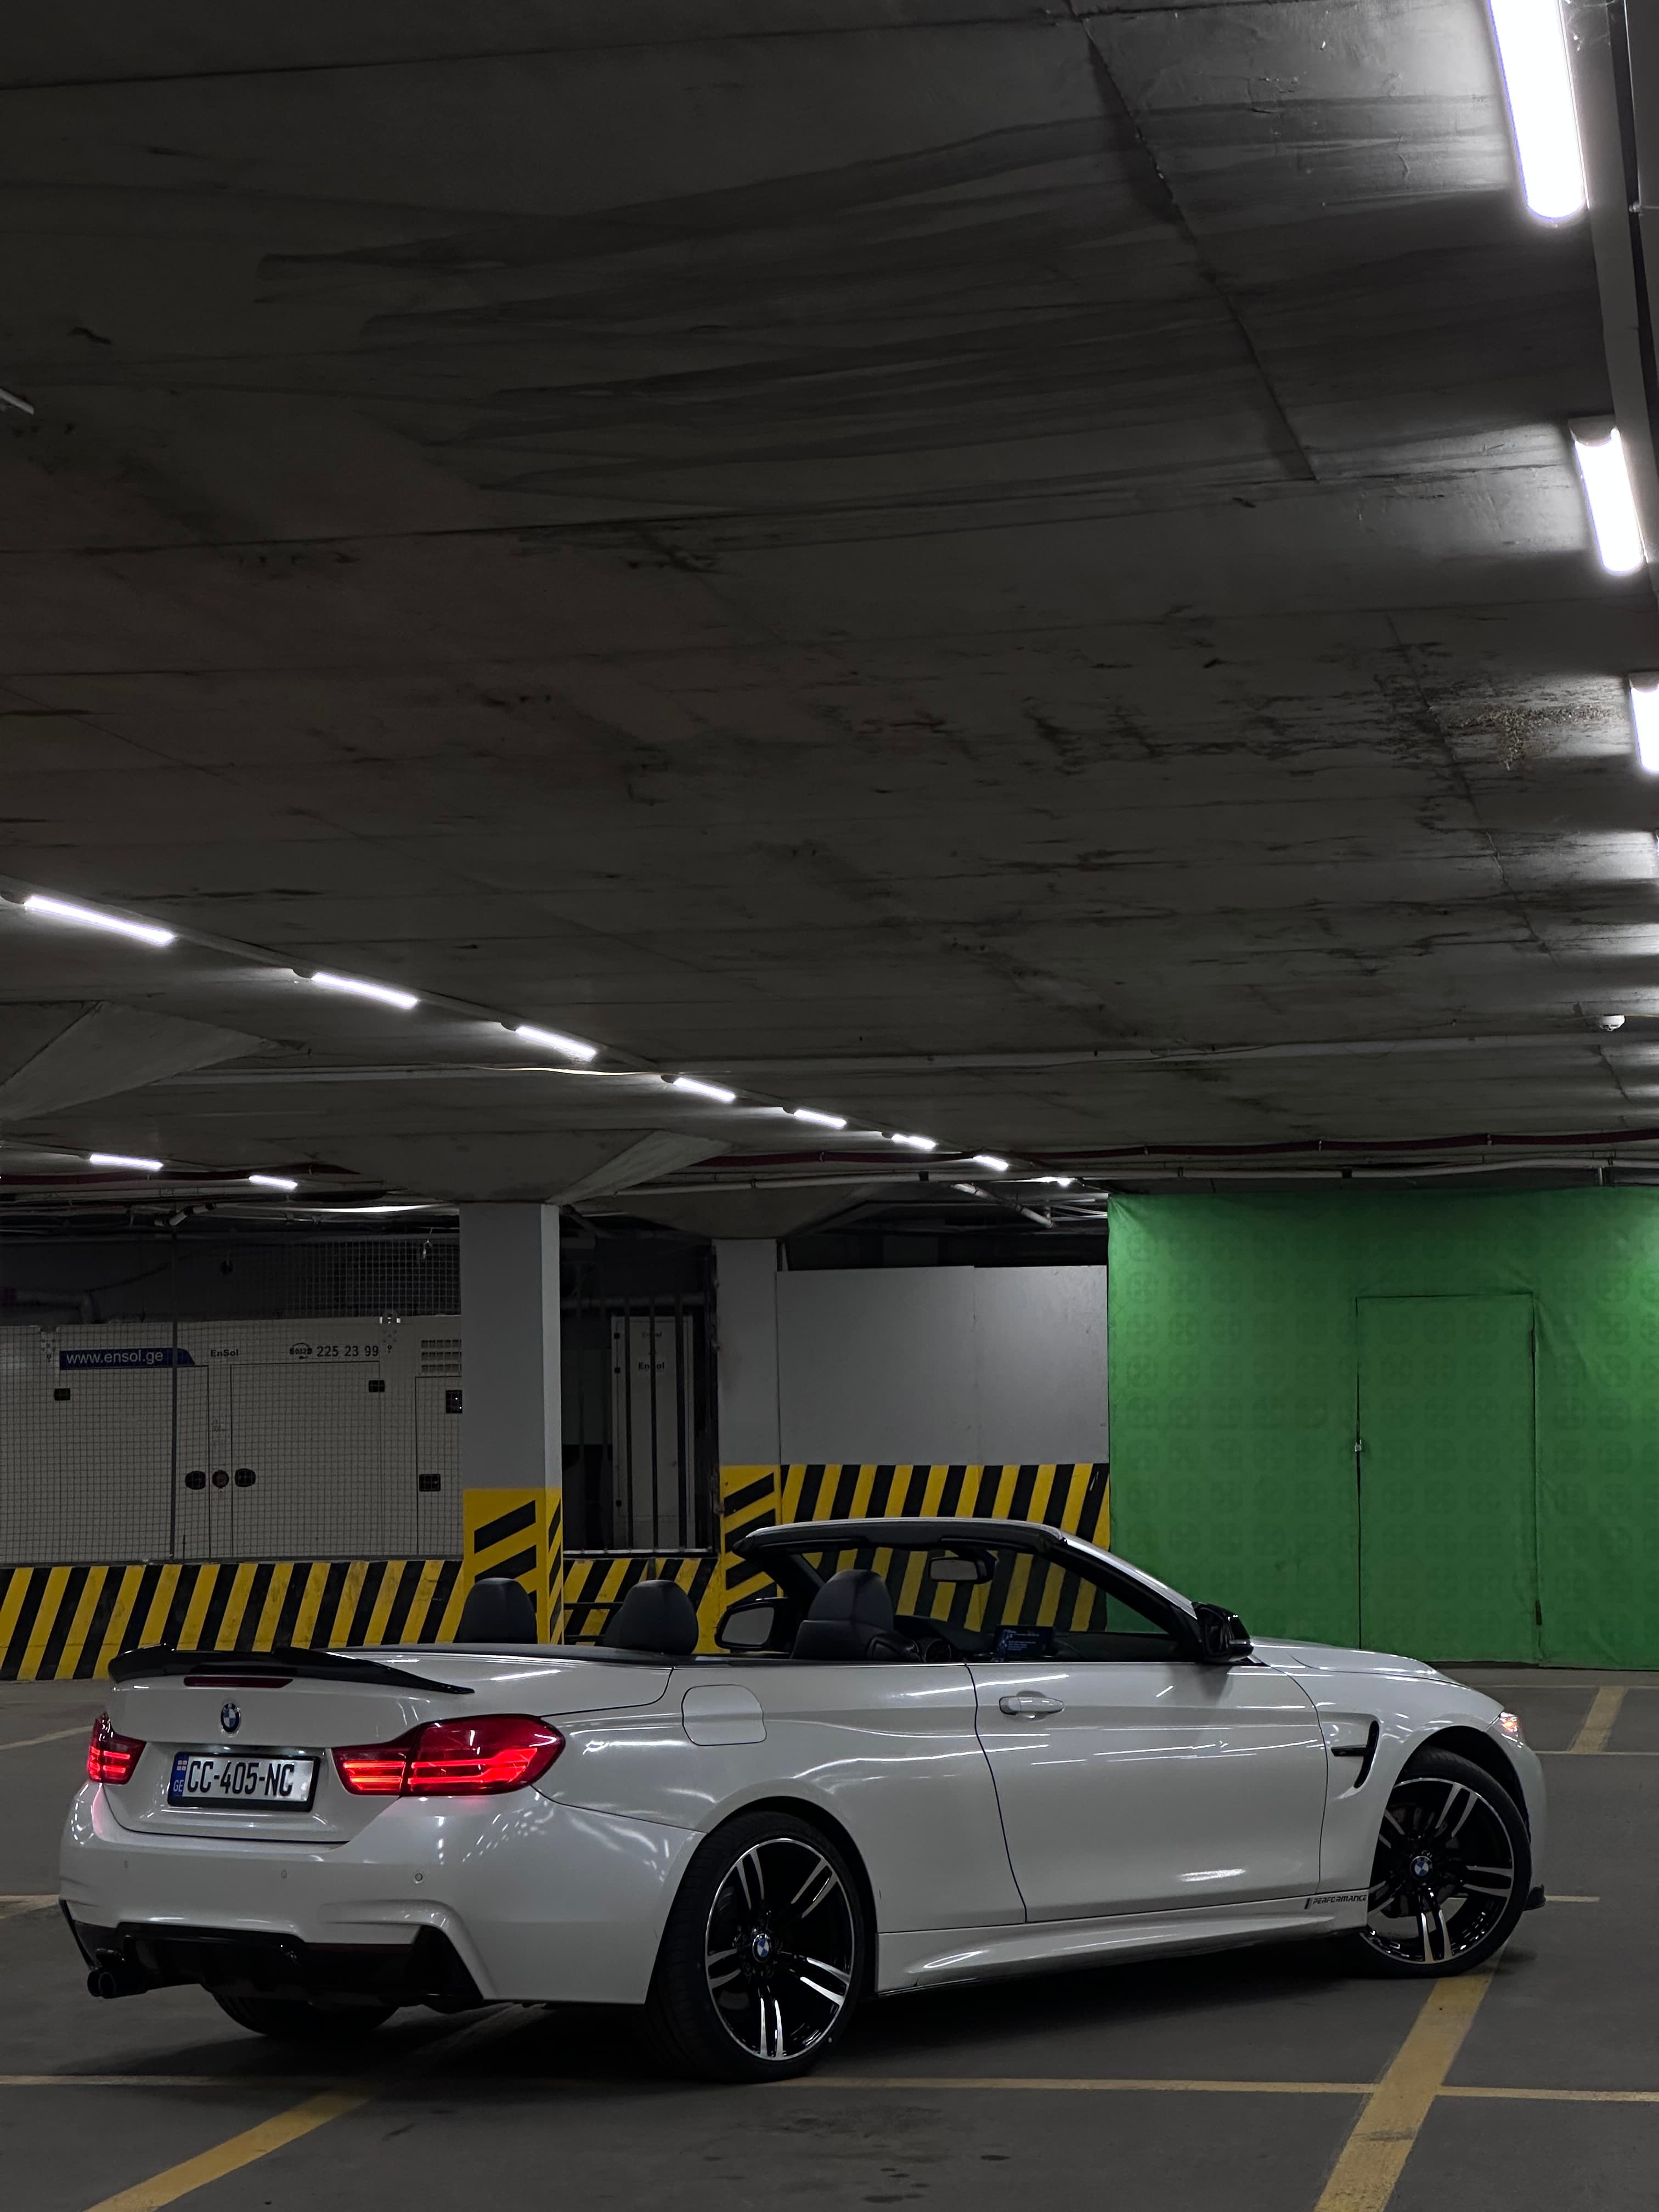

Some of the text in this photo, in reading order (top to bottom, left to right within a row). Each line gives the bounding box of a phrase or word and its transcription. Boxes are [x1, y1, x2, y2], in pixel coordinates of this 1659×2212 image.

[66, 1350, 163, 1364] www.ensol.ge
[210, 1349, 239, 1357] EnSol
[317, 1346, 339, 1357] 225
[345, 1346, 359, 1357] 23
[364, 1345, 379, 1356] 99
[188, 1761, 295, 1796] CC-405-NC
[173, 1780, 184, 1792] GE
[1312, 1895, 1367, 1904] PERFORMANCE
